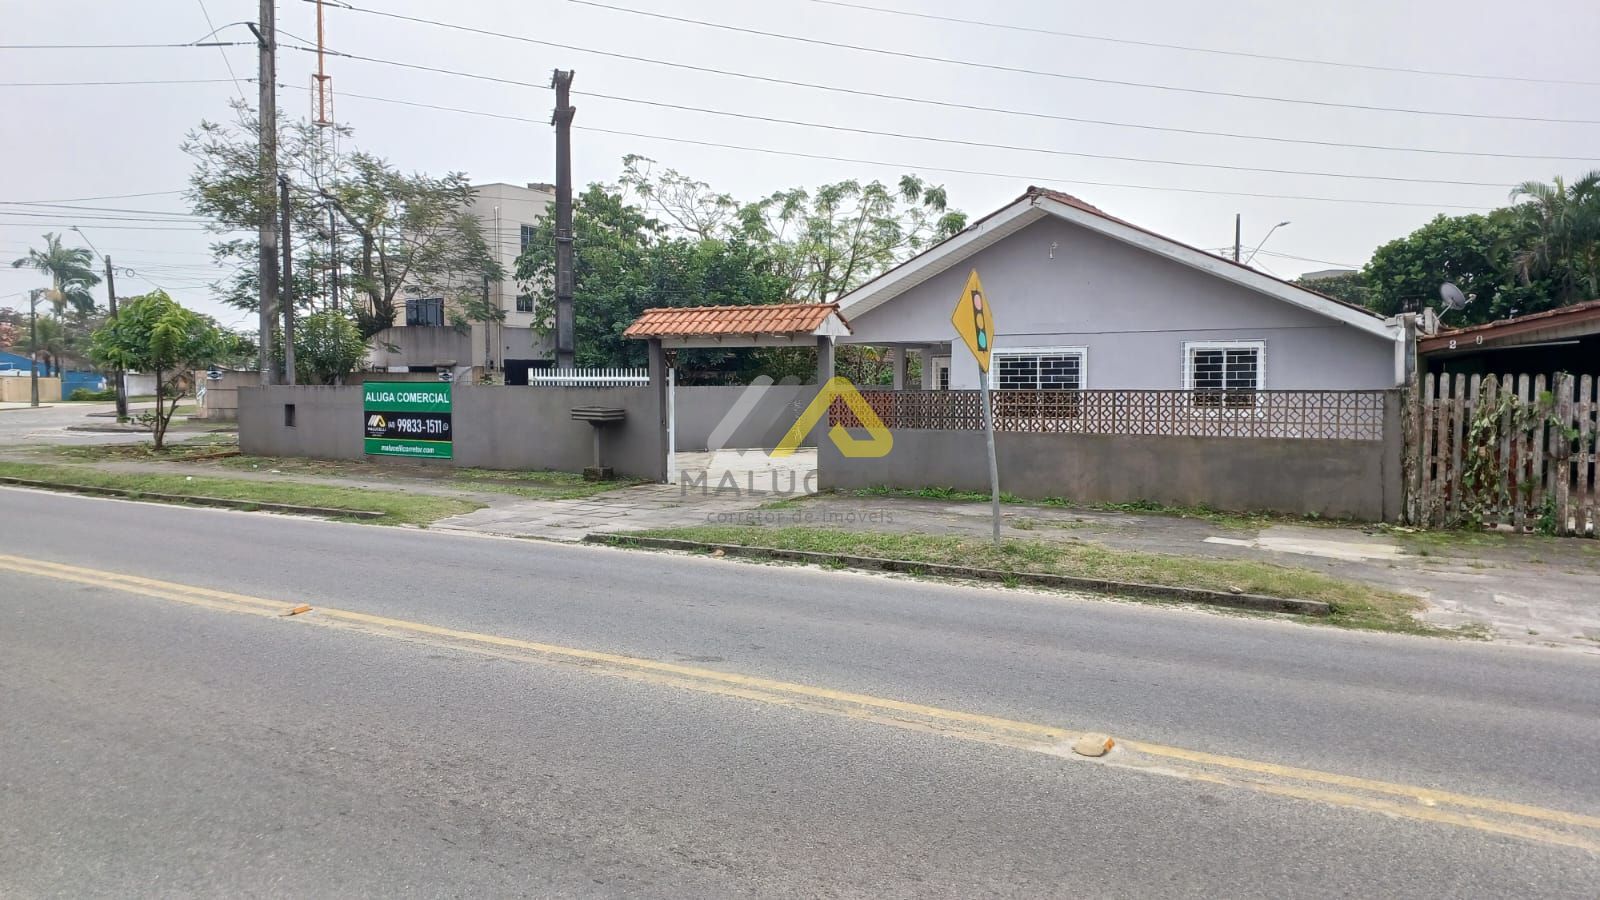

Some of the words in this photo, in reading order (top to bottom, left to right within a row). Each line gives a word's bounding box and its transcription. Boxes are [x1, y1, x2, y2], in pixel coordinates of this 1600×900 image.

[365, 392, 395, 402] ALUGA
[396, 392, 450, 404] COMERCIAL
[397, 418, 442, 434] 99833-1511
